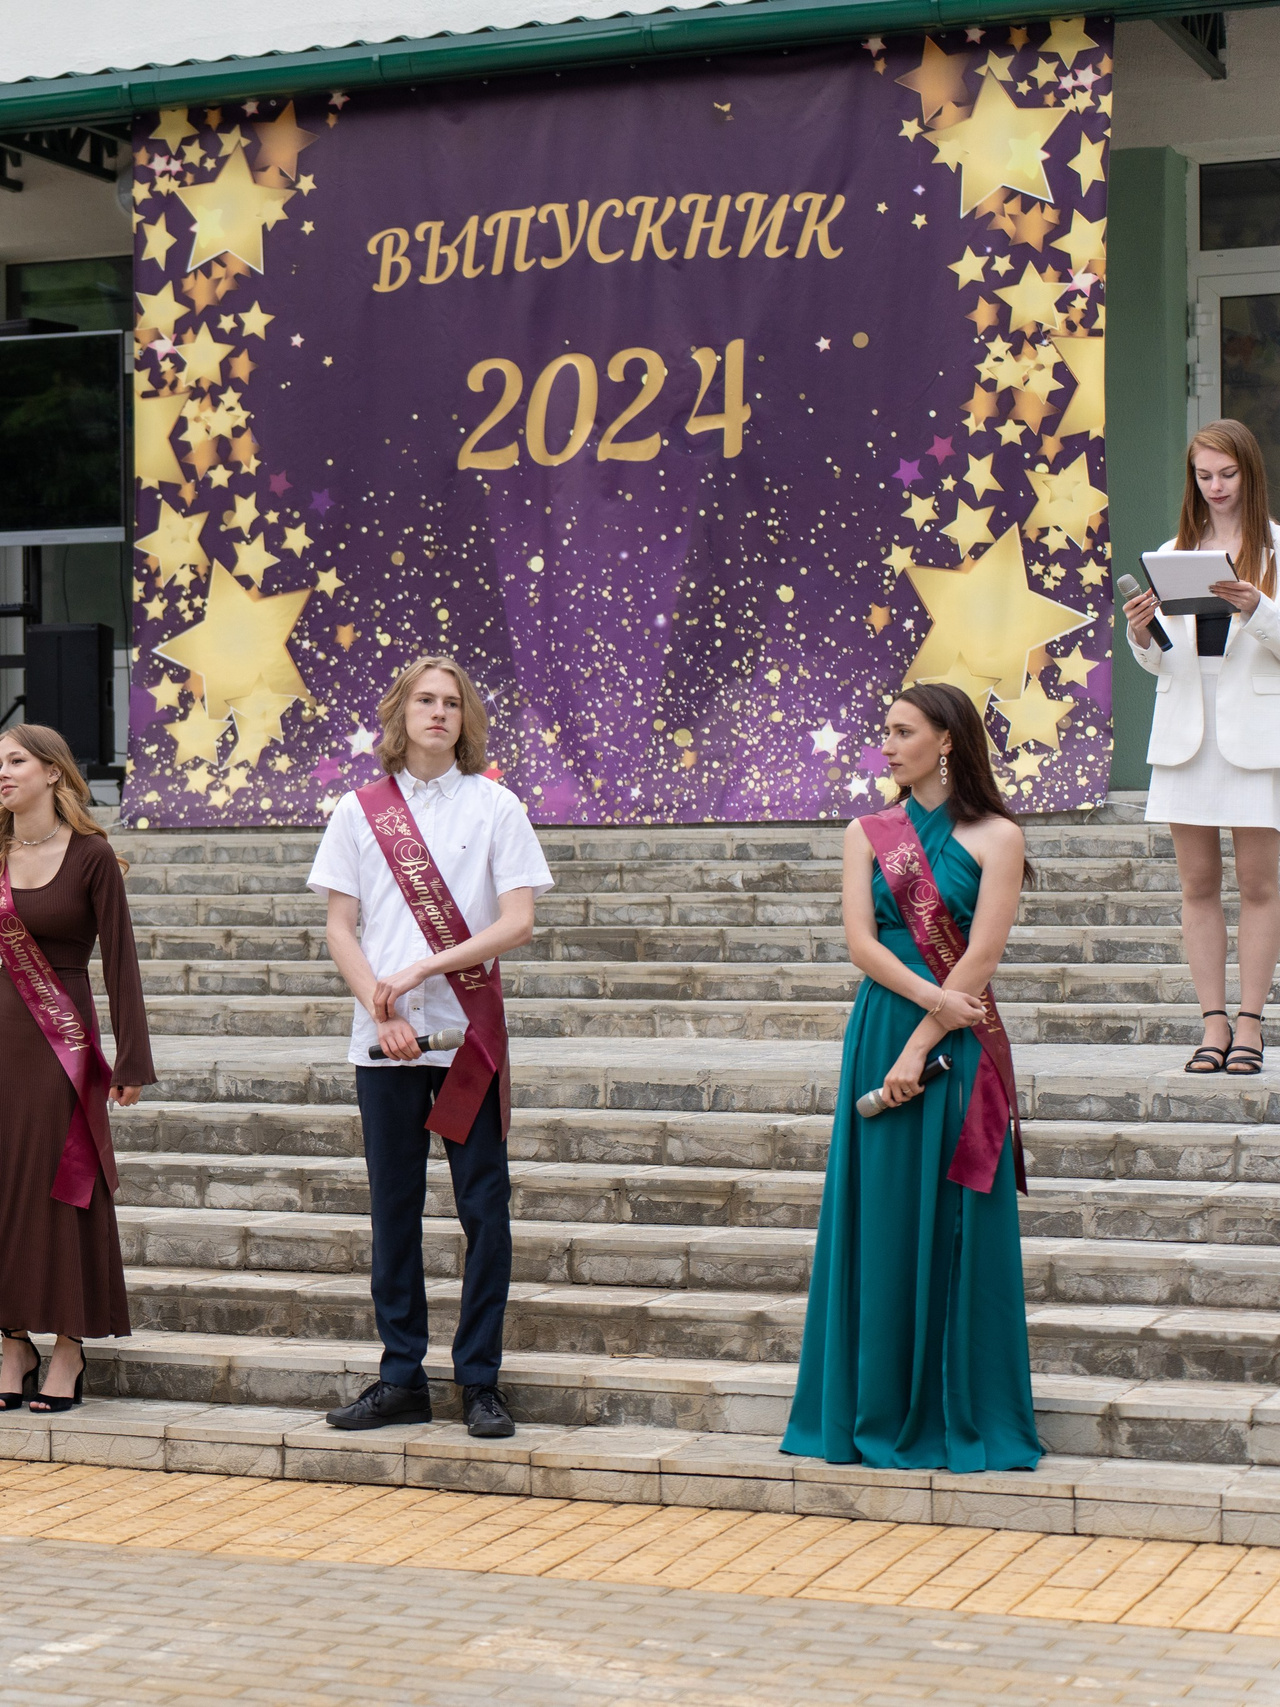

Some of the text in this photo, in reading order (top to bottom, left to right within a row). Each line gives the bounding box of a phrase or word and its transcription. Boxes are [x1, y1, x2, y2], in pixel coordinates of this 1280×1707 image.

[367, 192, 846, 292] ВЫПУСКНИК
[457, 339, 752, 471] 2024
[51, 1011, 90, 1052] 2024
